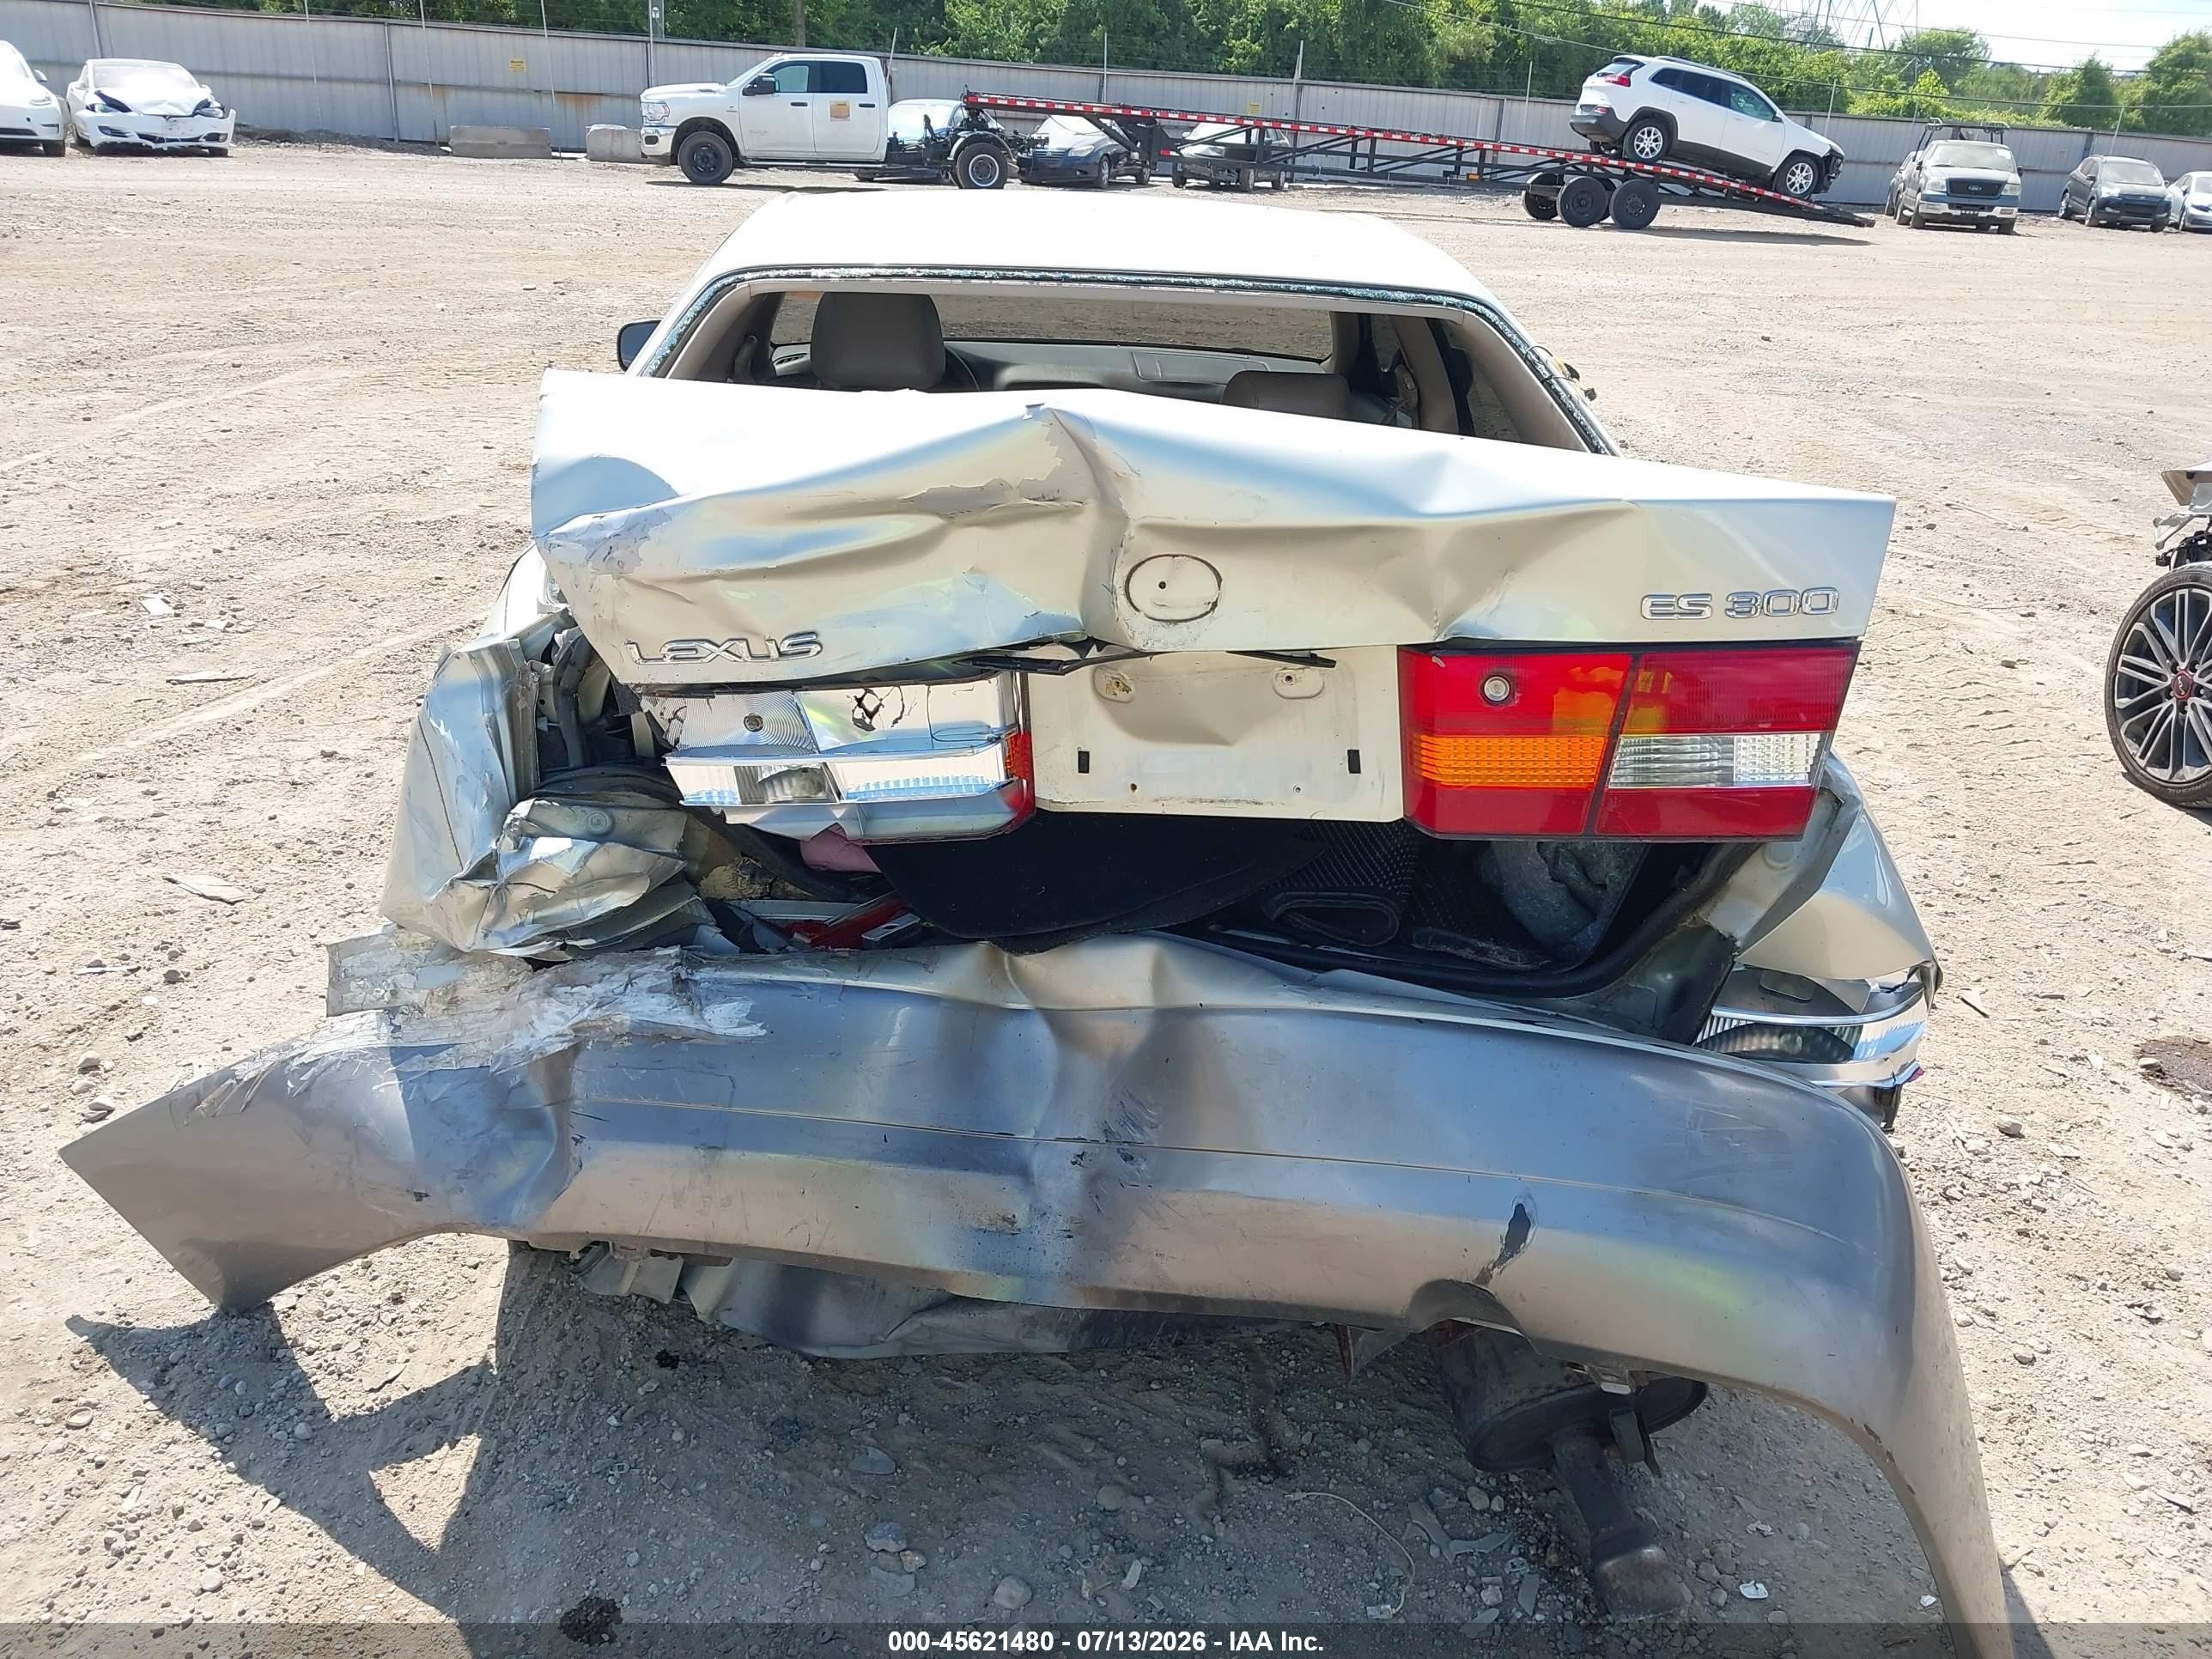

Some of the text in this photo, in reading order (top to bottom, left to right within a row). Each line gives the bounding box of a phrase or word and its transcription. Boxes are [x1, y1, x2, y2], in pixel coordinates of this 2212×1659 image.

[1640, 586, 1839, 620] ES 300
[623, 630, 823, 665] LEXUS
